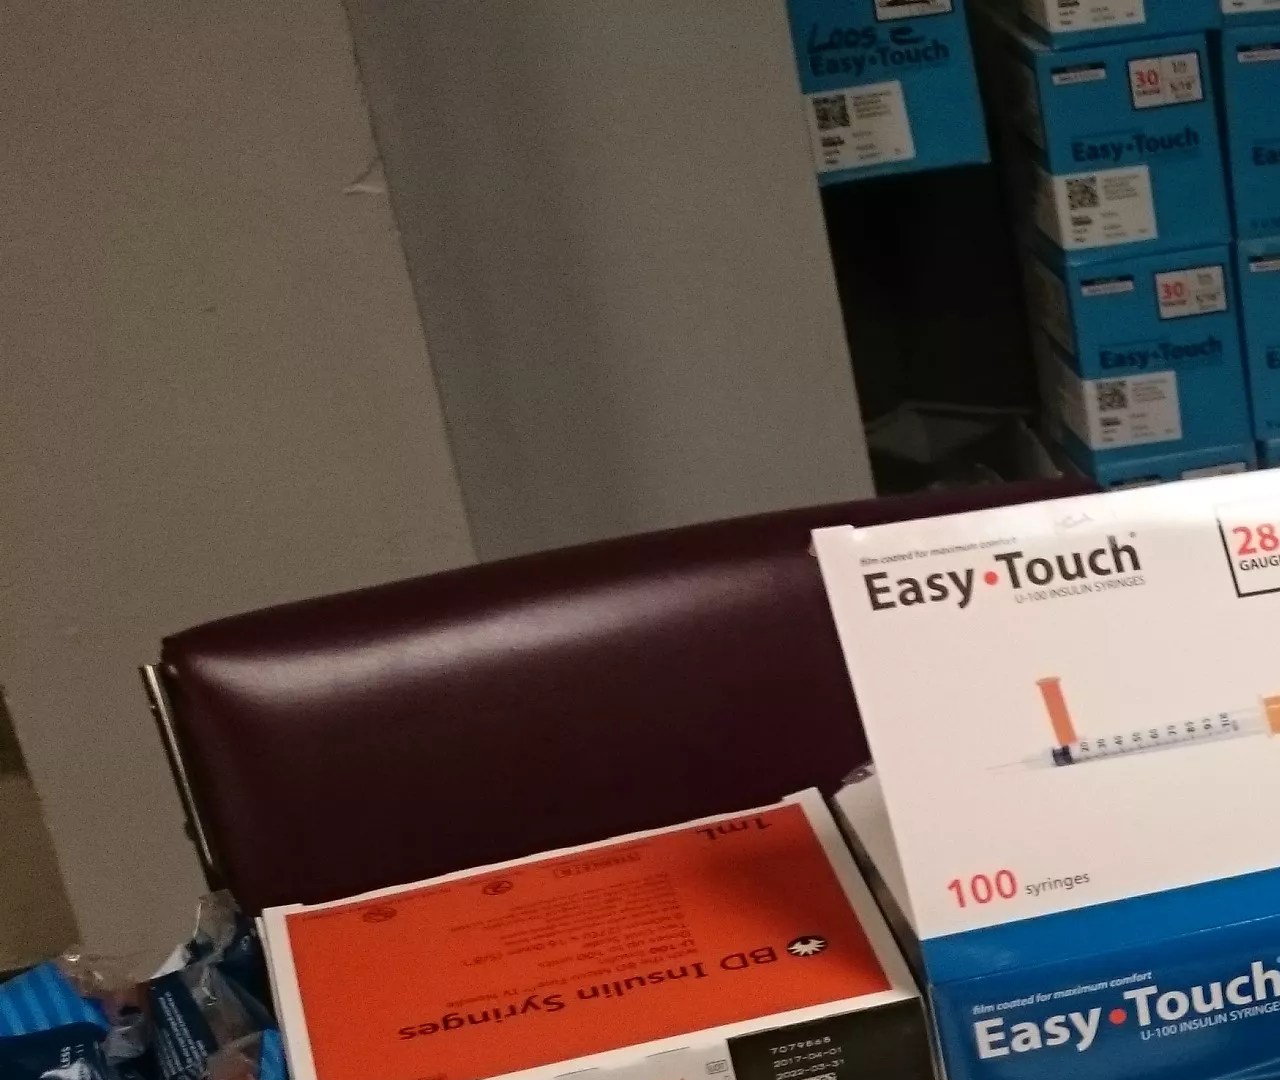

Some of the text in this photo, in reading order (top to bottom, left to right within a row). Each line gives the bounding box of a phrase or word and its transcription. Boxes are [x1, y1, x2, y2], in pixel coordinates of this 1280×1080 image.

[946, 869, 1092, 910] 100 syringes
[397, 946, 777, 1040] BD Insulin Syringes
[1180, 1012, 1228, 1033] INSULIN
